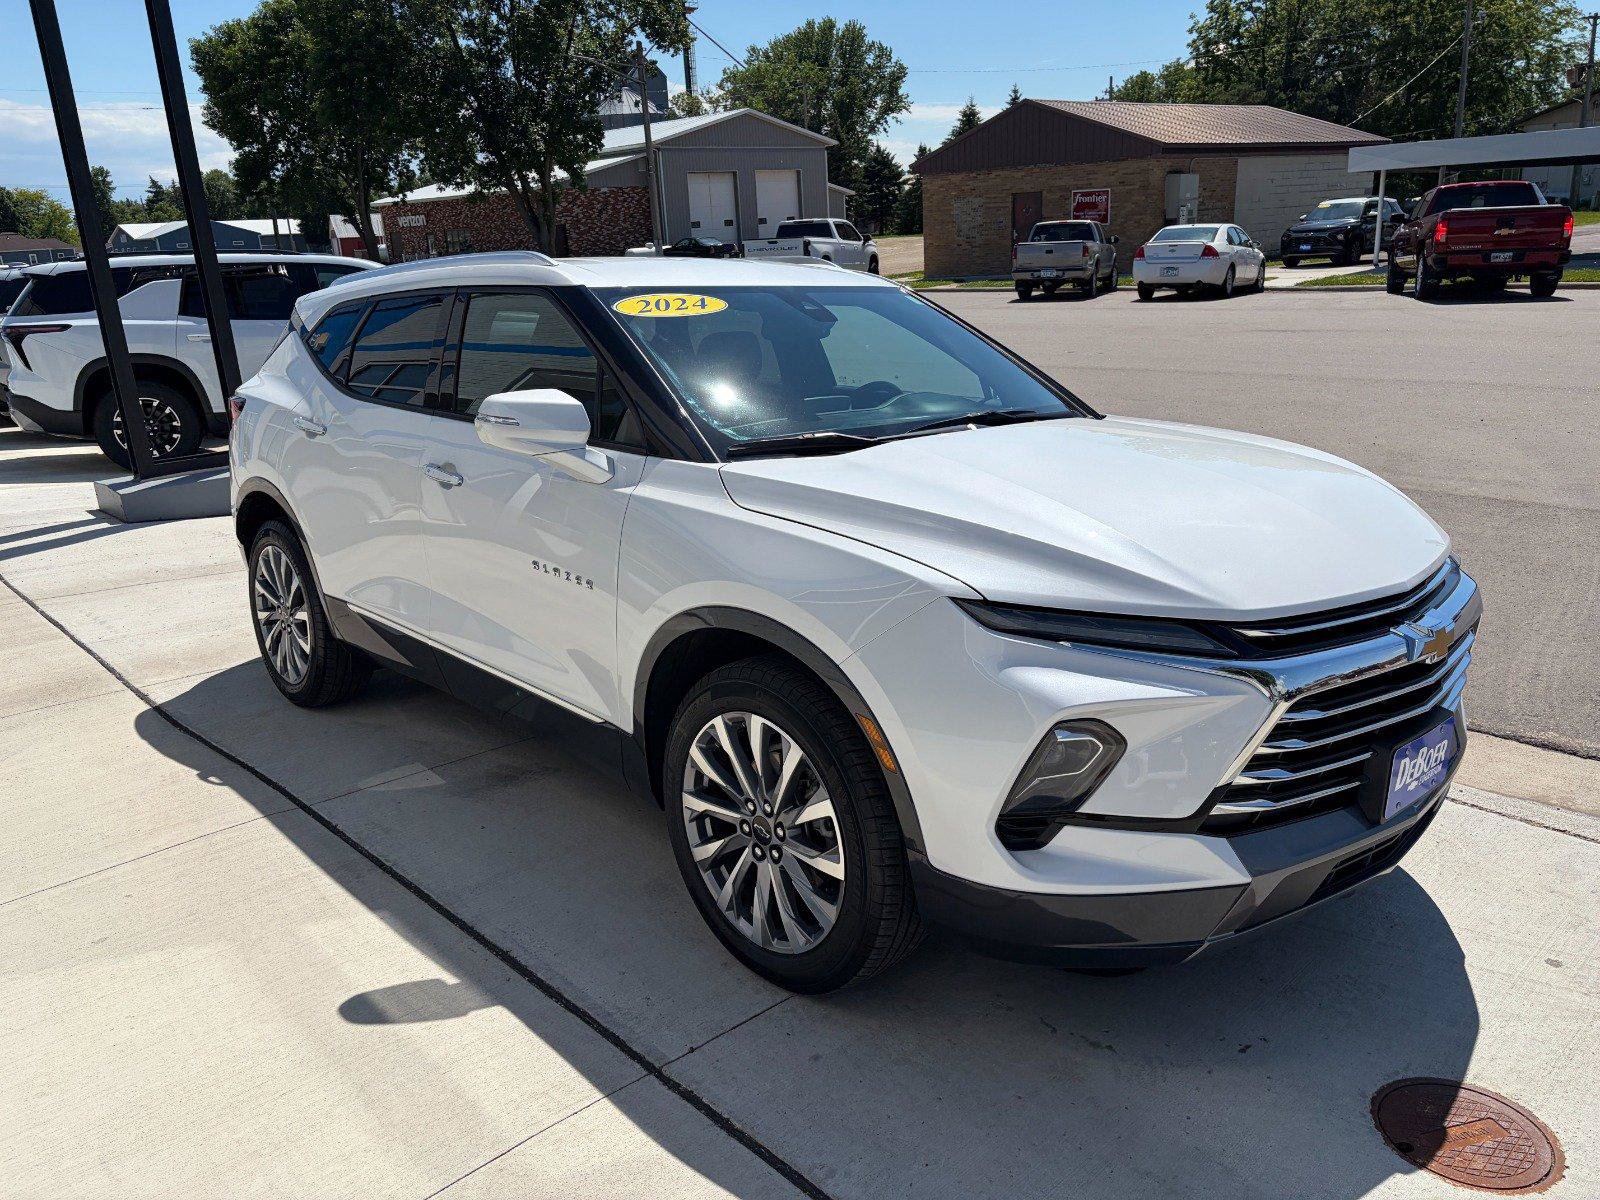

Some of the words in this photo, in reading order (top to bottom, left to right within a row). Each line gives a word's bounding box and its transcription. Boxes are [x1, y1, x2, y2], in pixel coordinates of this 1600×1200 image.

[1073, 193, 1108, 206] frontier
[397, 214, 427, 228] verizon
[747, 245, 799, 253] CHEVROLET
[635, 297, 708, 314] 2024
[531, 559, 594, 590] BLAZER
